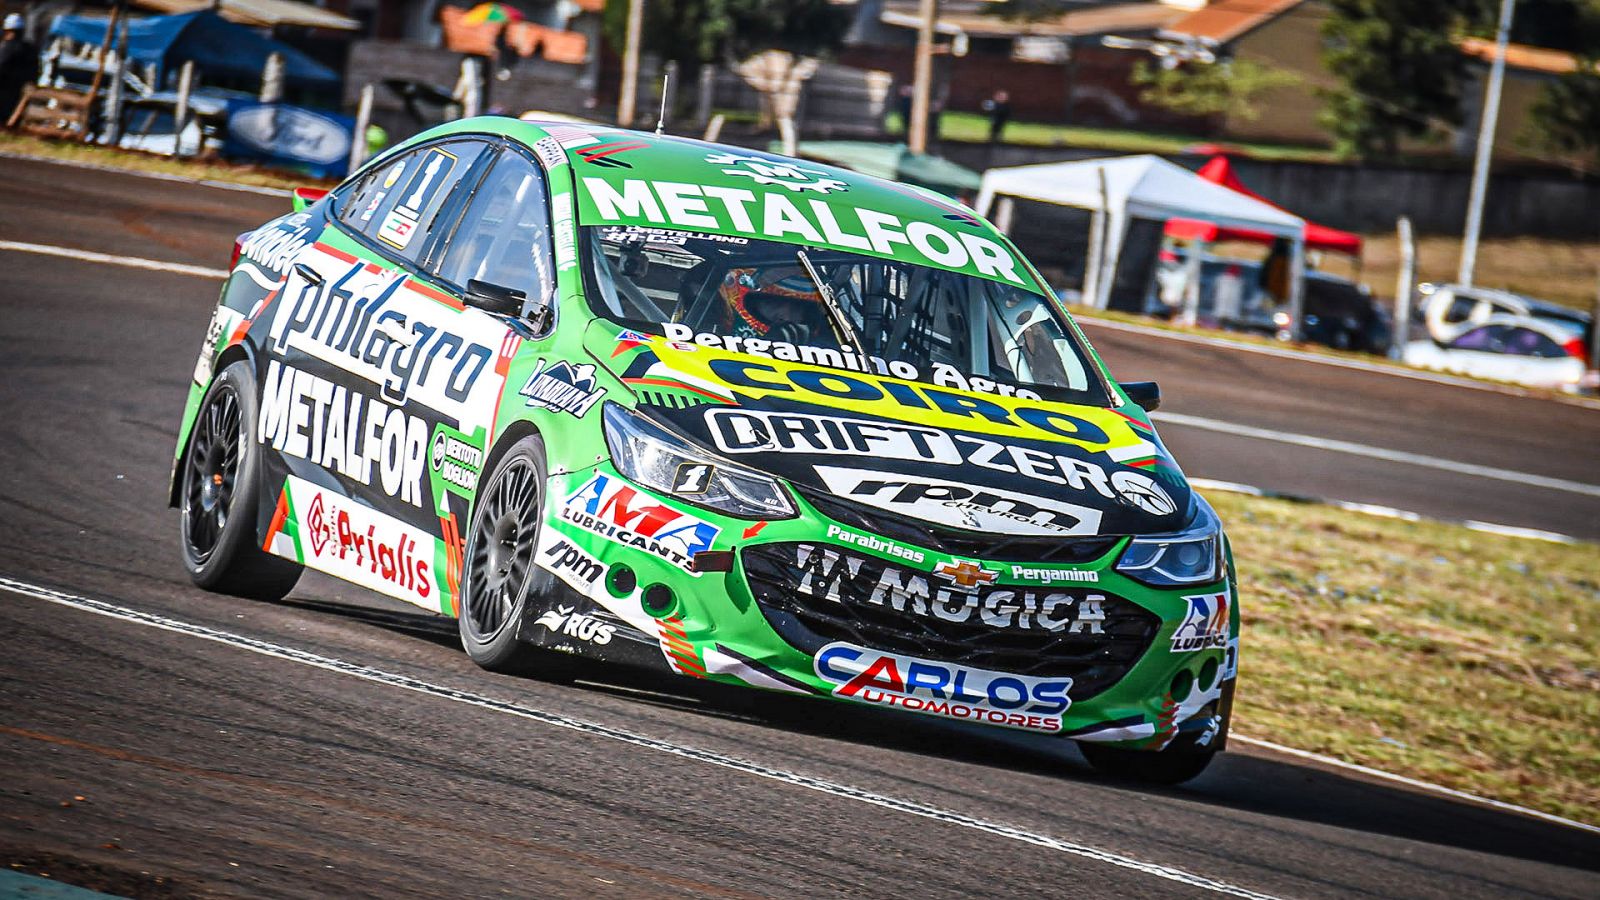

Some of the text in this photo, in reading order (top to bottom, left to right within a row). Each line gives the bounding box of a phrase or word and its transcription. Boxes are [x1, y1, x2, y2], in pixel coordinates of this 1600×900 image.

[582, 177, 1027, 286] METALFOR
[278, 261, 493, 403] philagro
[661, 322, 1043, 401] Pergamino Agro
[258, 359, 428, 508] METALFOR
[708, 358, 1109, 445] COIRO
[676, 465, 708, 491] 1
[851, 480, 1081, 529] rpm
[563, 508, 695, 572] LUBRICANTS
[566, 475, 719, 558] AMA
[827, 523, 925, 563] Parabrisas
[942, 501, 1069, 532] CHEVROLET
[337, 510, 431, 598] Prialis
[545, 540, 604, 583] rpm
[1011, 565, 1099, 584] Pergamino
[818, 645, 1069, 716] CARLOS
